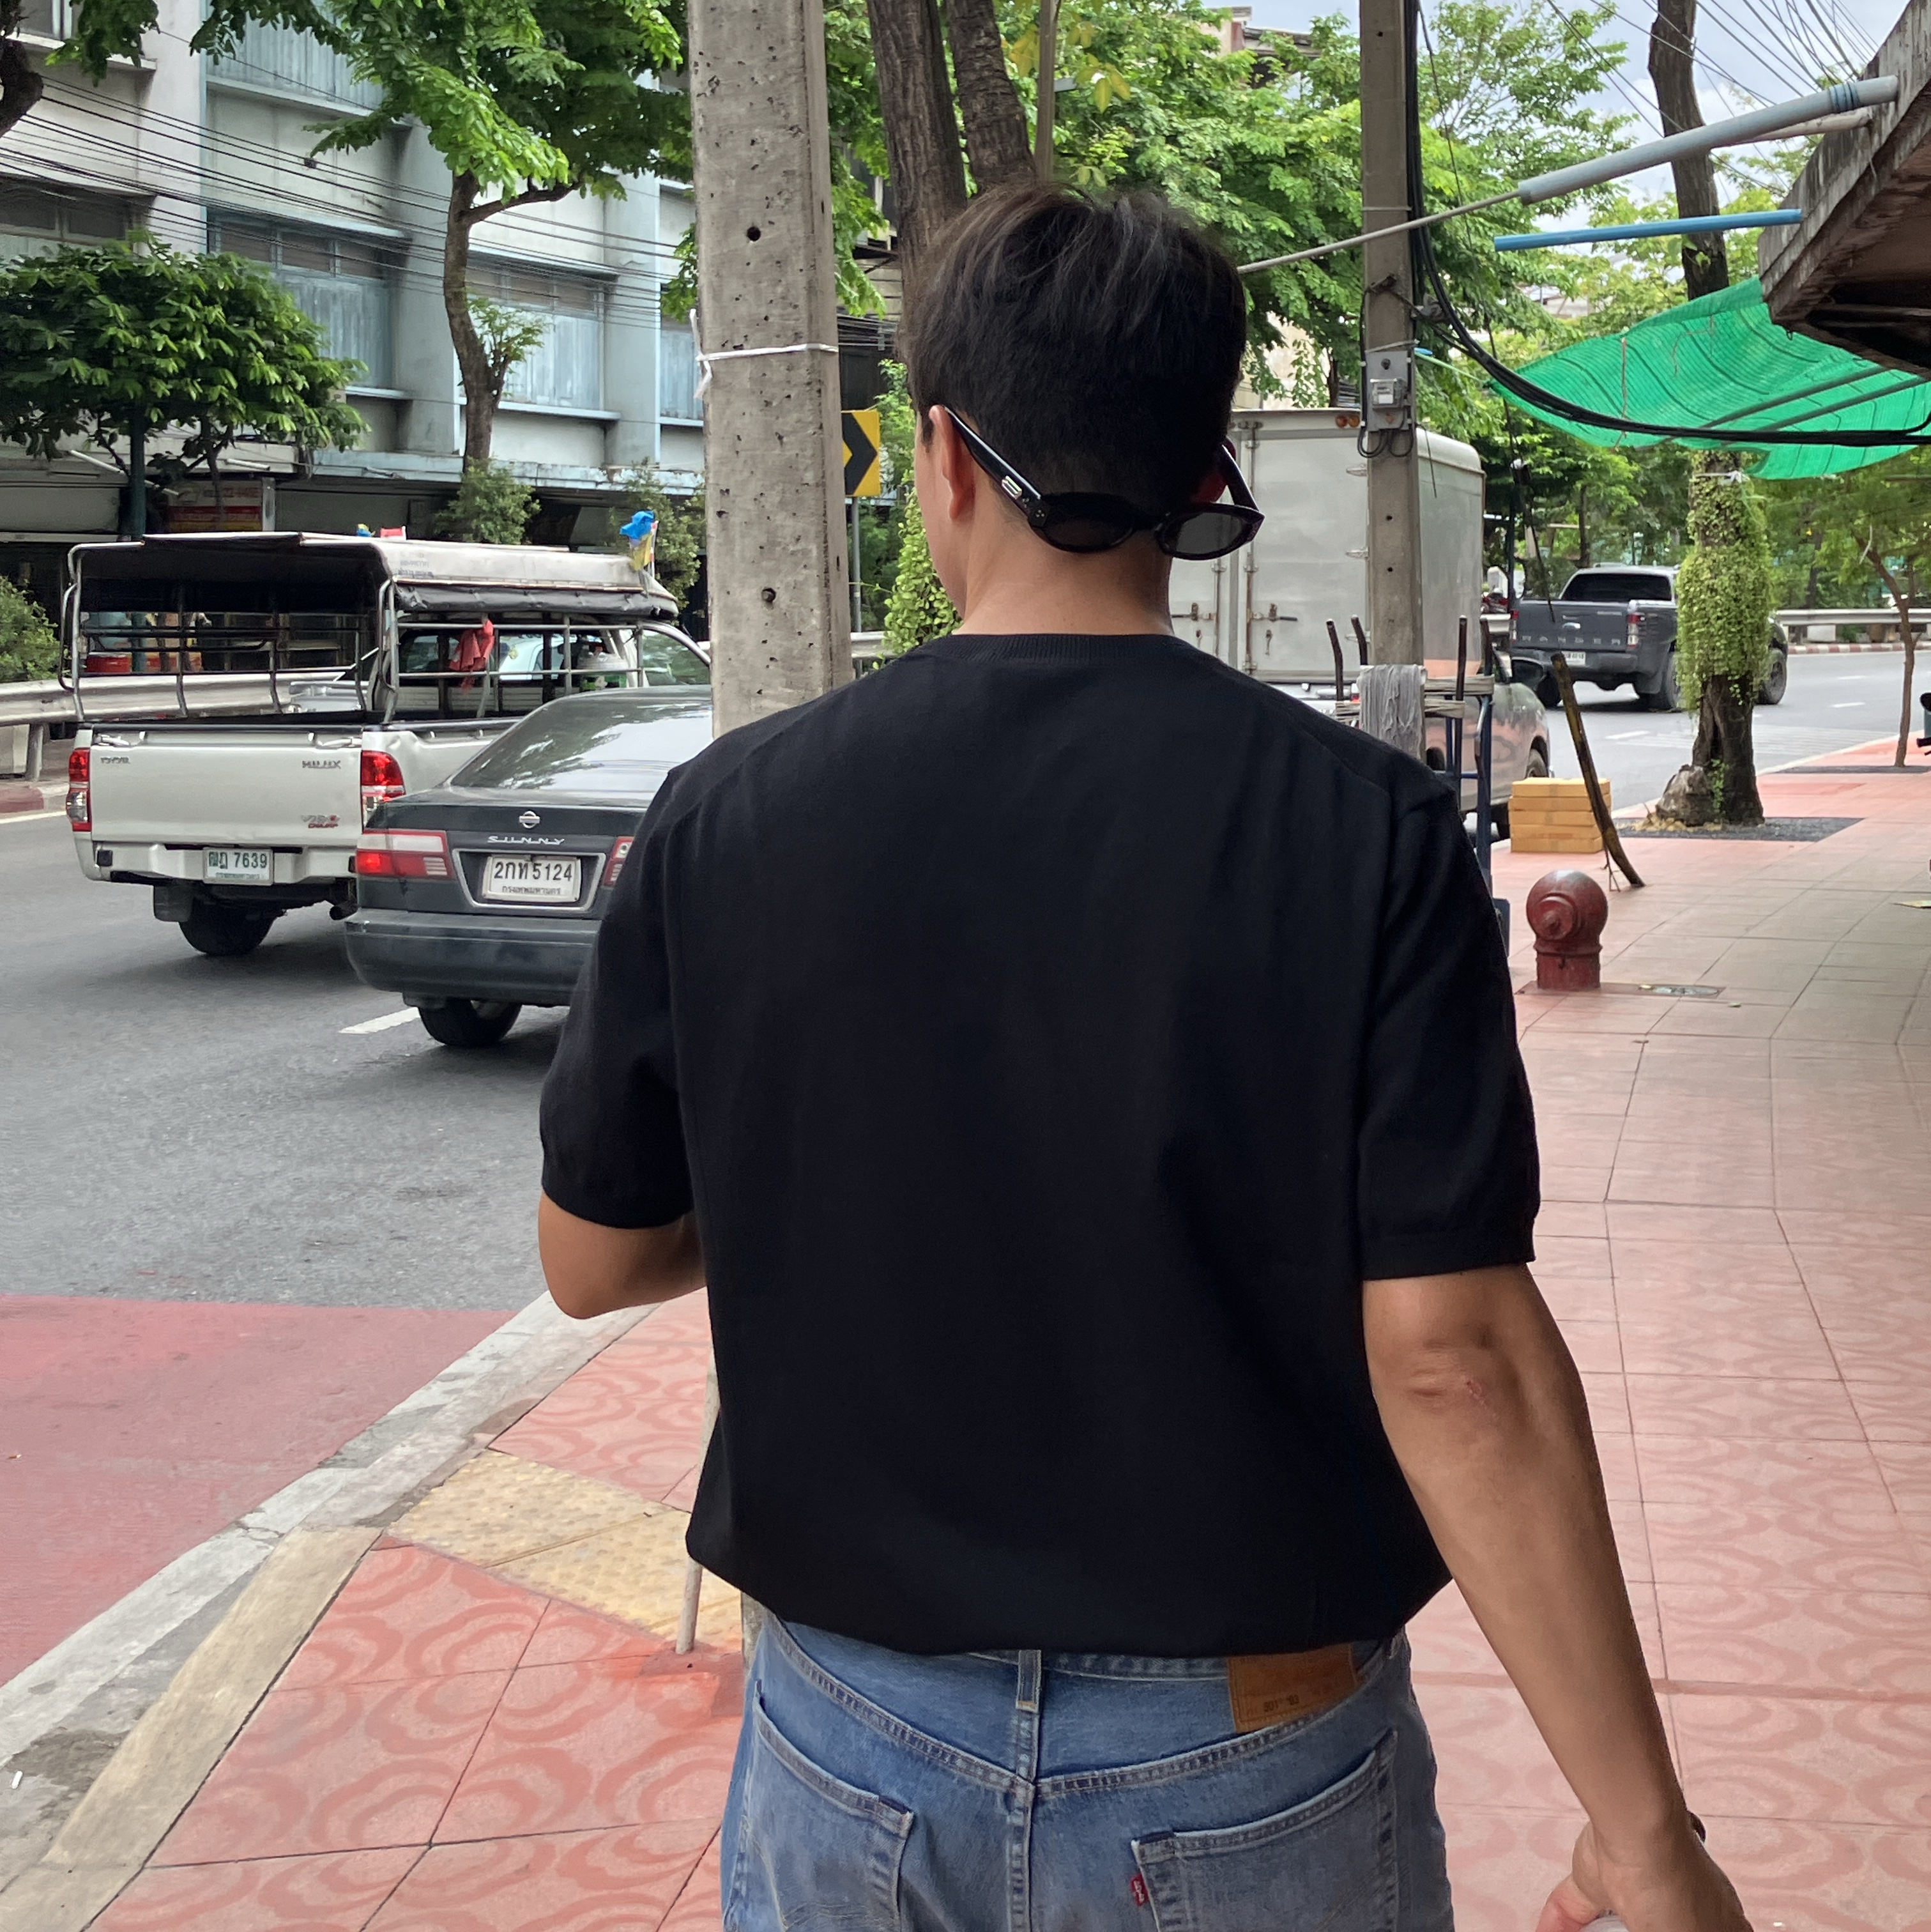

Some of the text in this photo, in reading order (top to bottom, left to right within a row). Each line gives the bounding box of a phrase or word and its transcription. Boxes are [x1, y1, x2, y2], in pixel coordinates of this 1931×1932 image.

[487, 835, 565, 846] SUNNY
[233, 852, 267, 868] 7639
[532, 862, 572, 881] 5124
